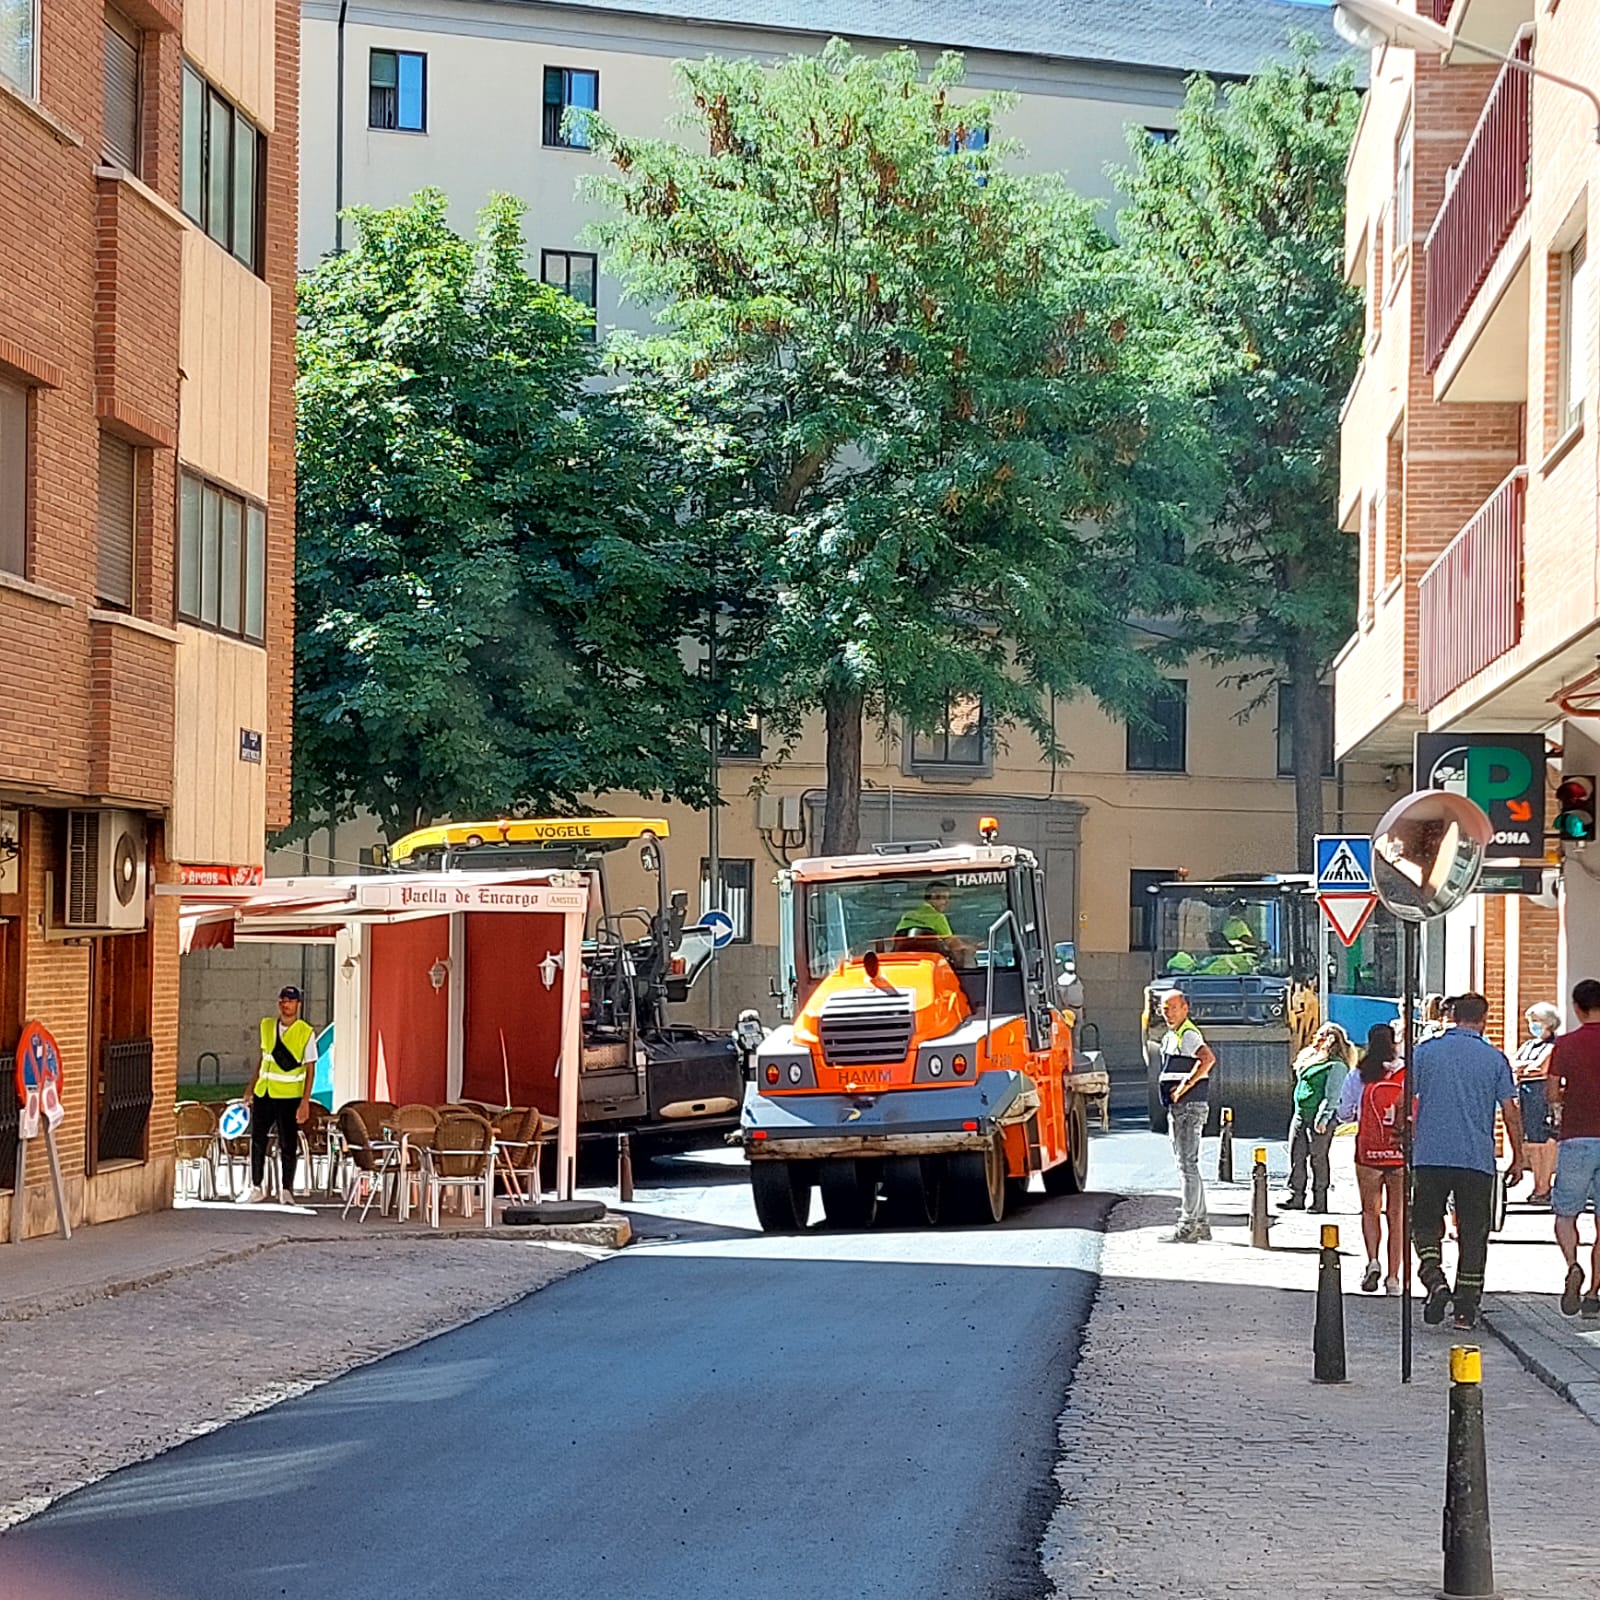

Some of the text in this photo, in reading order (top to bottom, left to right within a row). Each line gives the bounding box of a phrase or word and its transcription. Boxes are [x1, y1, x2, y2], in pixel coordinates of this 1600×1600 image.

[1467, 746, 1532, 817] P
[534, 823, 592, 838] VÖGELE
[955, 870, 1007, 887] HAMM
[400, 887, 539, 907] Paella de Encargo
[838, 1068, 893, 1085] HAMM
